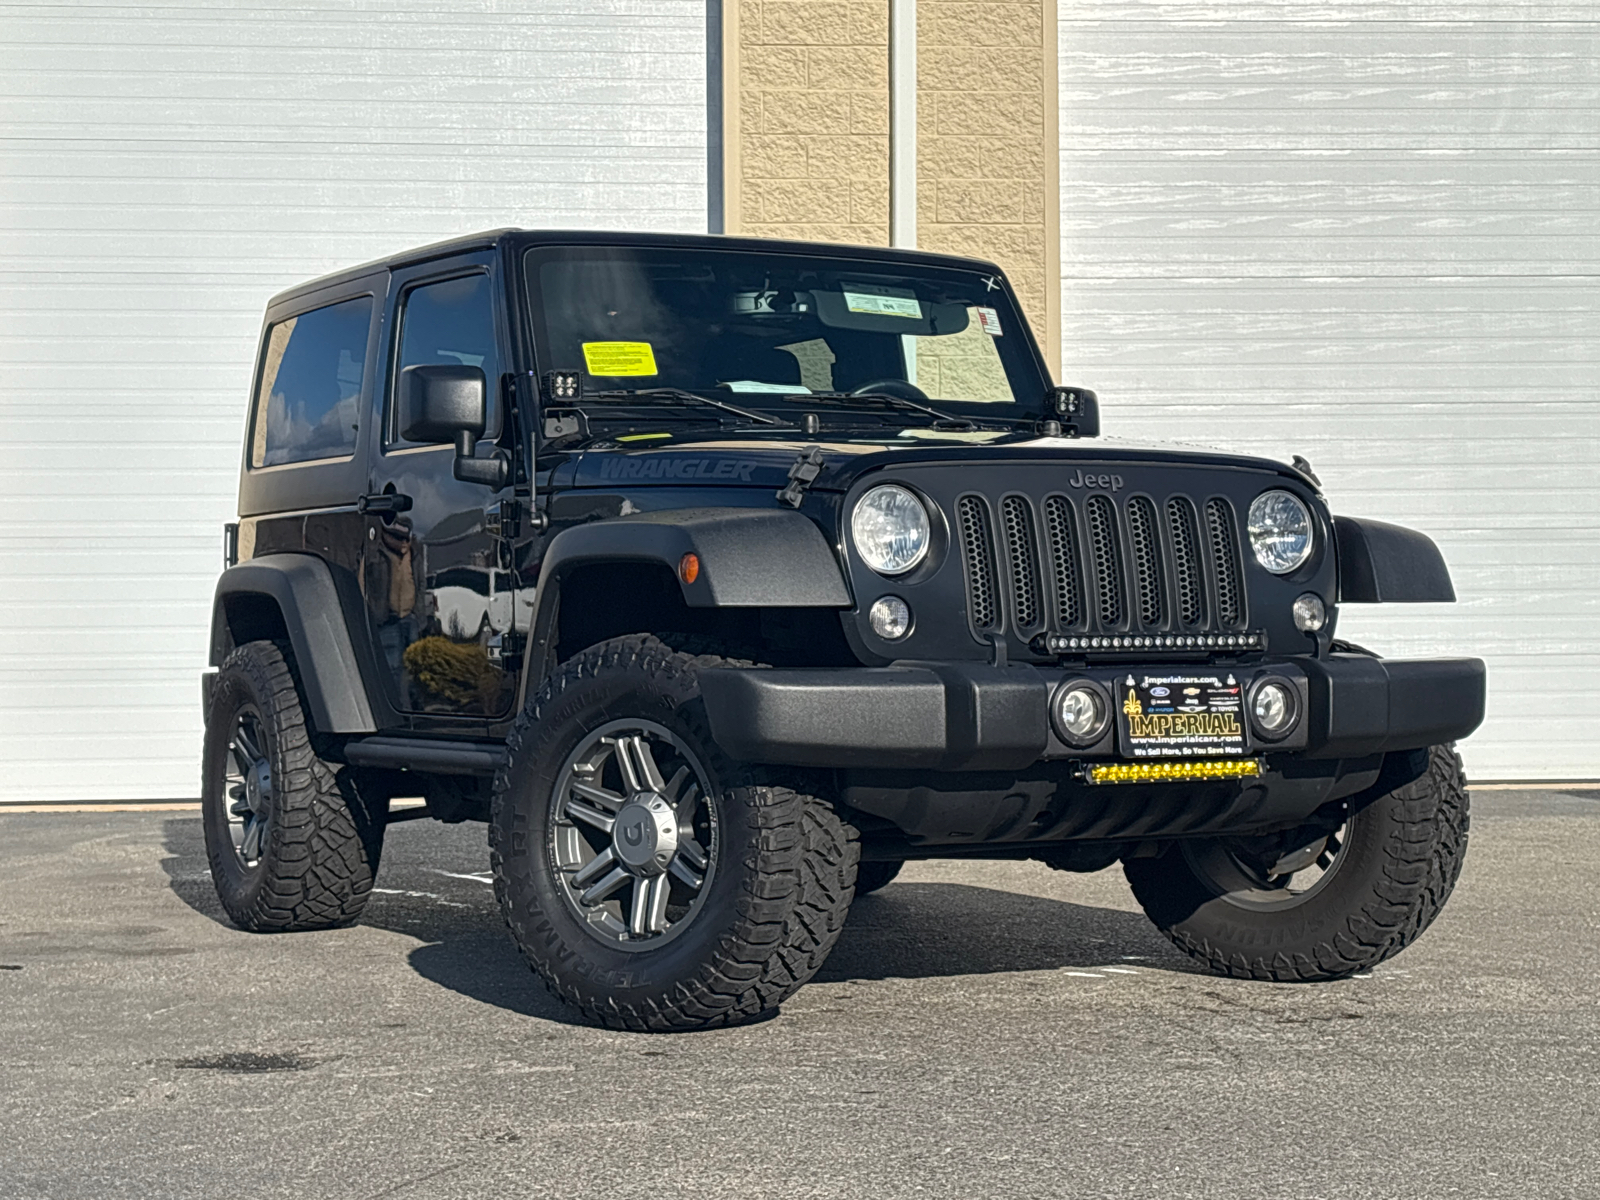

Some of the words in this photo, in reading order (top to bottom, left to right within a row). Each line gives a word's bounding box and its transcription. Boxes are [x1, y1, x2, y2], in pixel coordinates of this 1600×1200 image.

[600, 458, 758, 482] WRANGLER
[1069, 469, 1124, 491] Jeep
[1129, 713, 1241, 736] IMPERIAL
[1162, 747, 1181, 756] More,
[1182, 747, 1192, 755] So
[1207, 746, 1224, 754] Save
[1225, 746, 1243, 754] More
[511, 804, 528, 857] RT
[514, 867, 652, 989] TERRAMAX
